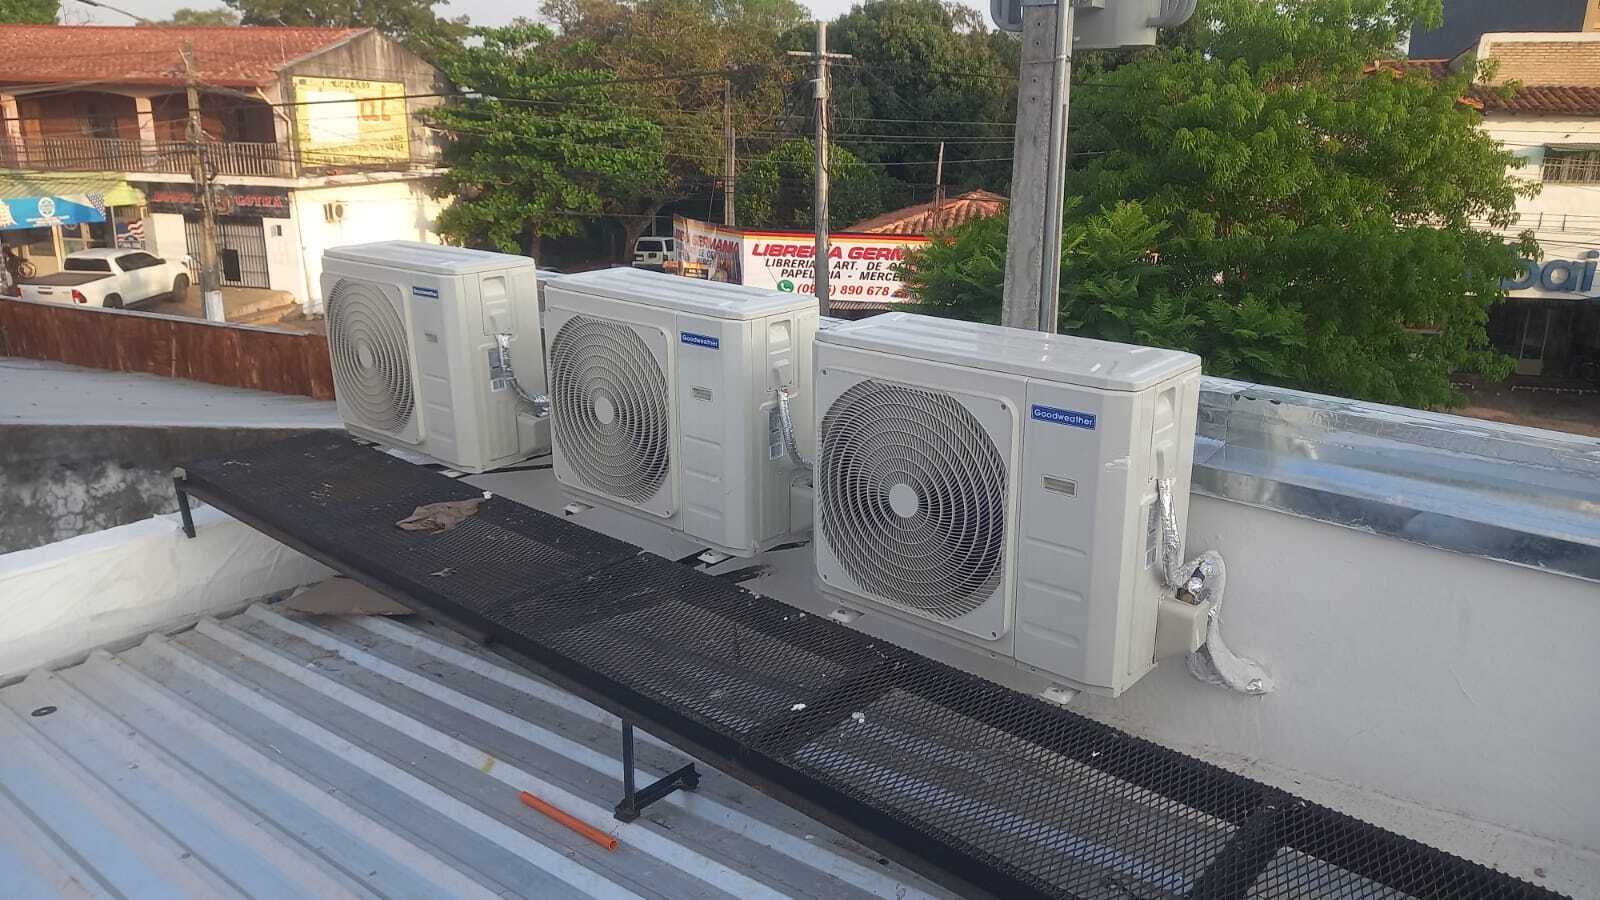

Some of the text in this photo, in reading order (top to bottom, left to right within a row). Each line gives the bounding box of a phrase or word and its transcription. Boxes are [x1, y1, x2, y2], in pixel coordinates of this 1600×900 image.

[752, 243, 905, 261] LIBREA GERM
[833, 261, 859, 271] ART.
[866, 261, 882, 271] DE
[780, 268, 841, 280] PAPELIA
[840, 285, 863, 296] 890
[866, 286, 890, 297] 678
[1034, 408, 1093, 426] Goodweather
